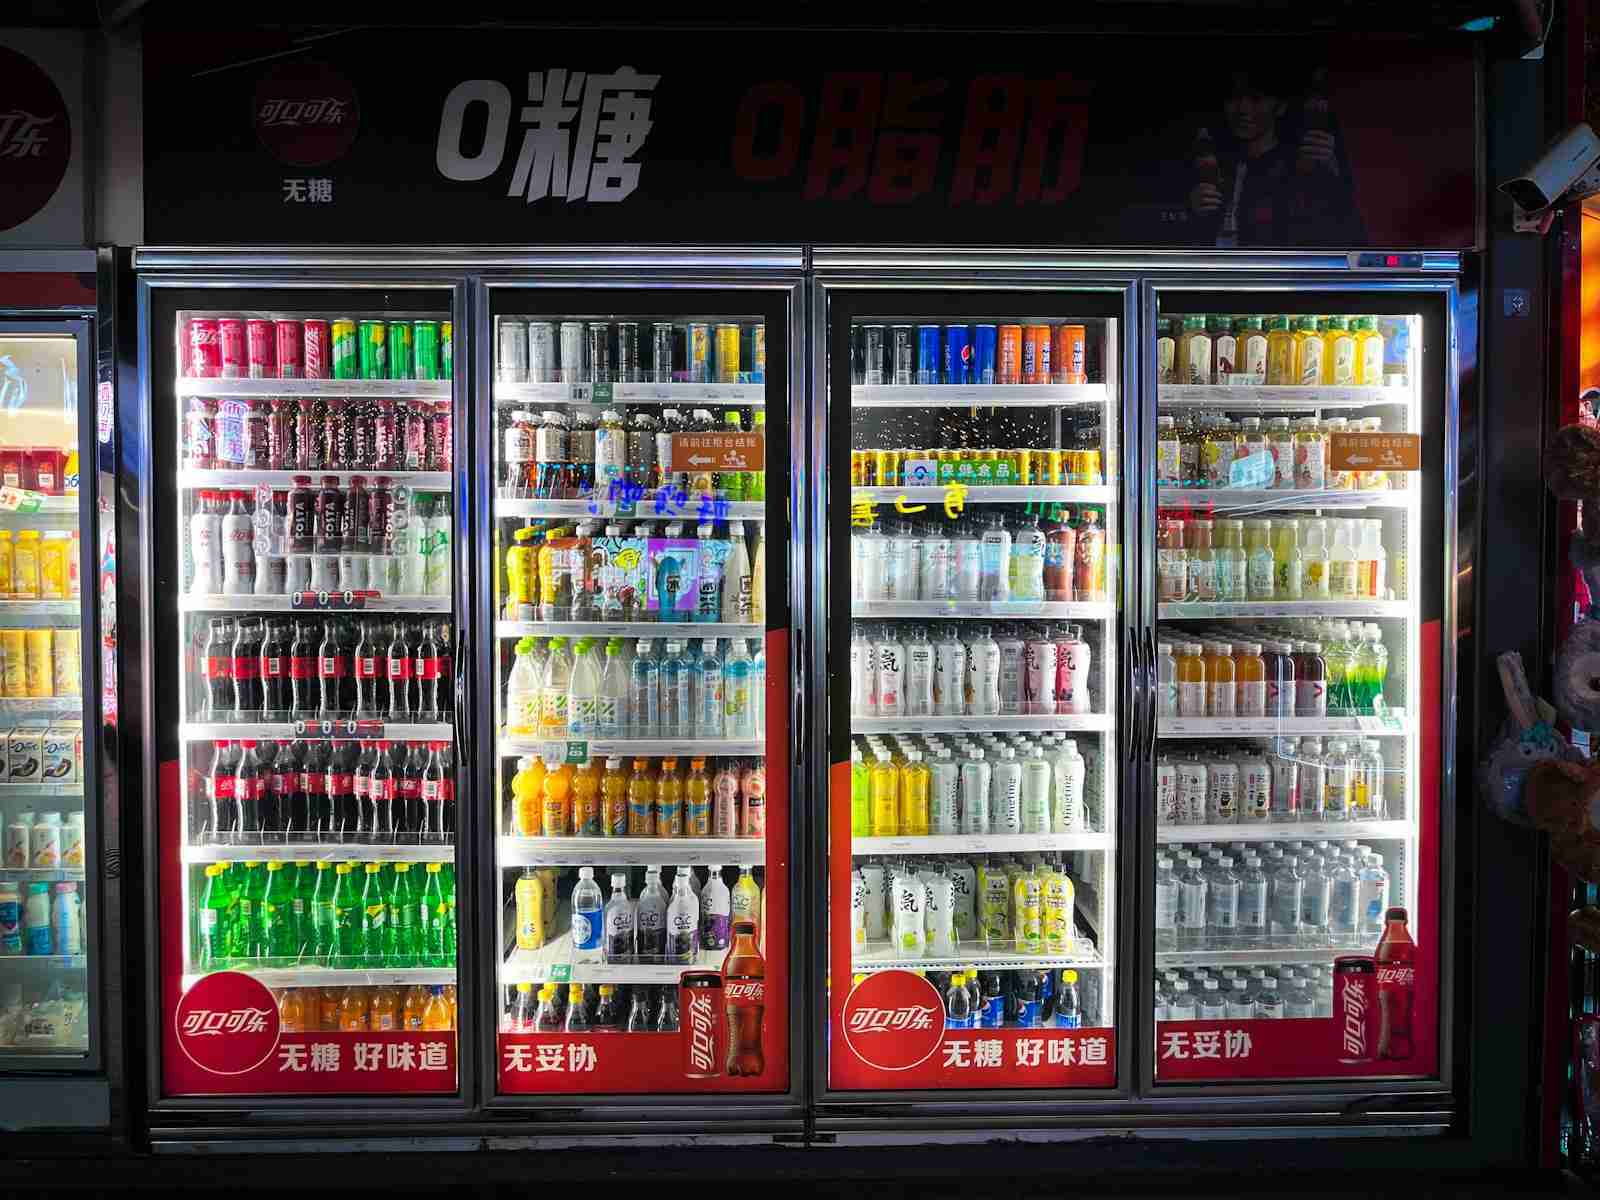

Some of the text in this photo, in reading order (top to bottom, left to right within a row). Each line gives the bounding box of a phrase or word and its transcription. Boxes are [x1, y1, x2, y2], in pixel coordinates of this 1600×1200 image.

[259, 97, 349, 127] 可口可乐
[436, 65, 662, 204] 0糖
[282, 178, 333, 204] 无糖
[296, 502, 305, 538] COSTA
[326, 502, 336, 538] COSTA
[292, 591, 354, 605] 0 0 0
[295, 720, 357, 734] 0 0 0
[183, 1008, 272, 1036] 可口可乐
[689, 990, 715, 1071] 可口可乐
[849, 1005, 938, 1032] 可口可乐
[1342, 977, 1366, 1057] 可口可乐
[279, 1042, 448, 1072] 无糖 好味道
[504, 1043, 598, 1073] 无妥协
[942, 1038, 1107, 1068] 无糖 好味道
[1161, 1030, 1252, 1060] 无妥协
